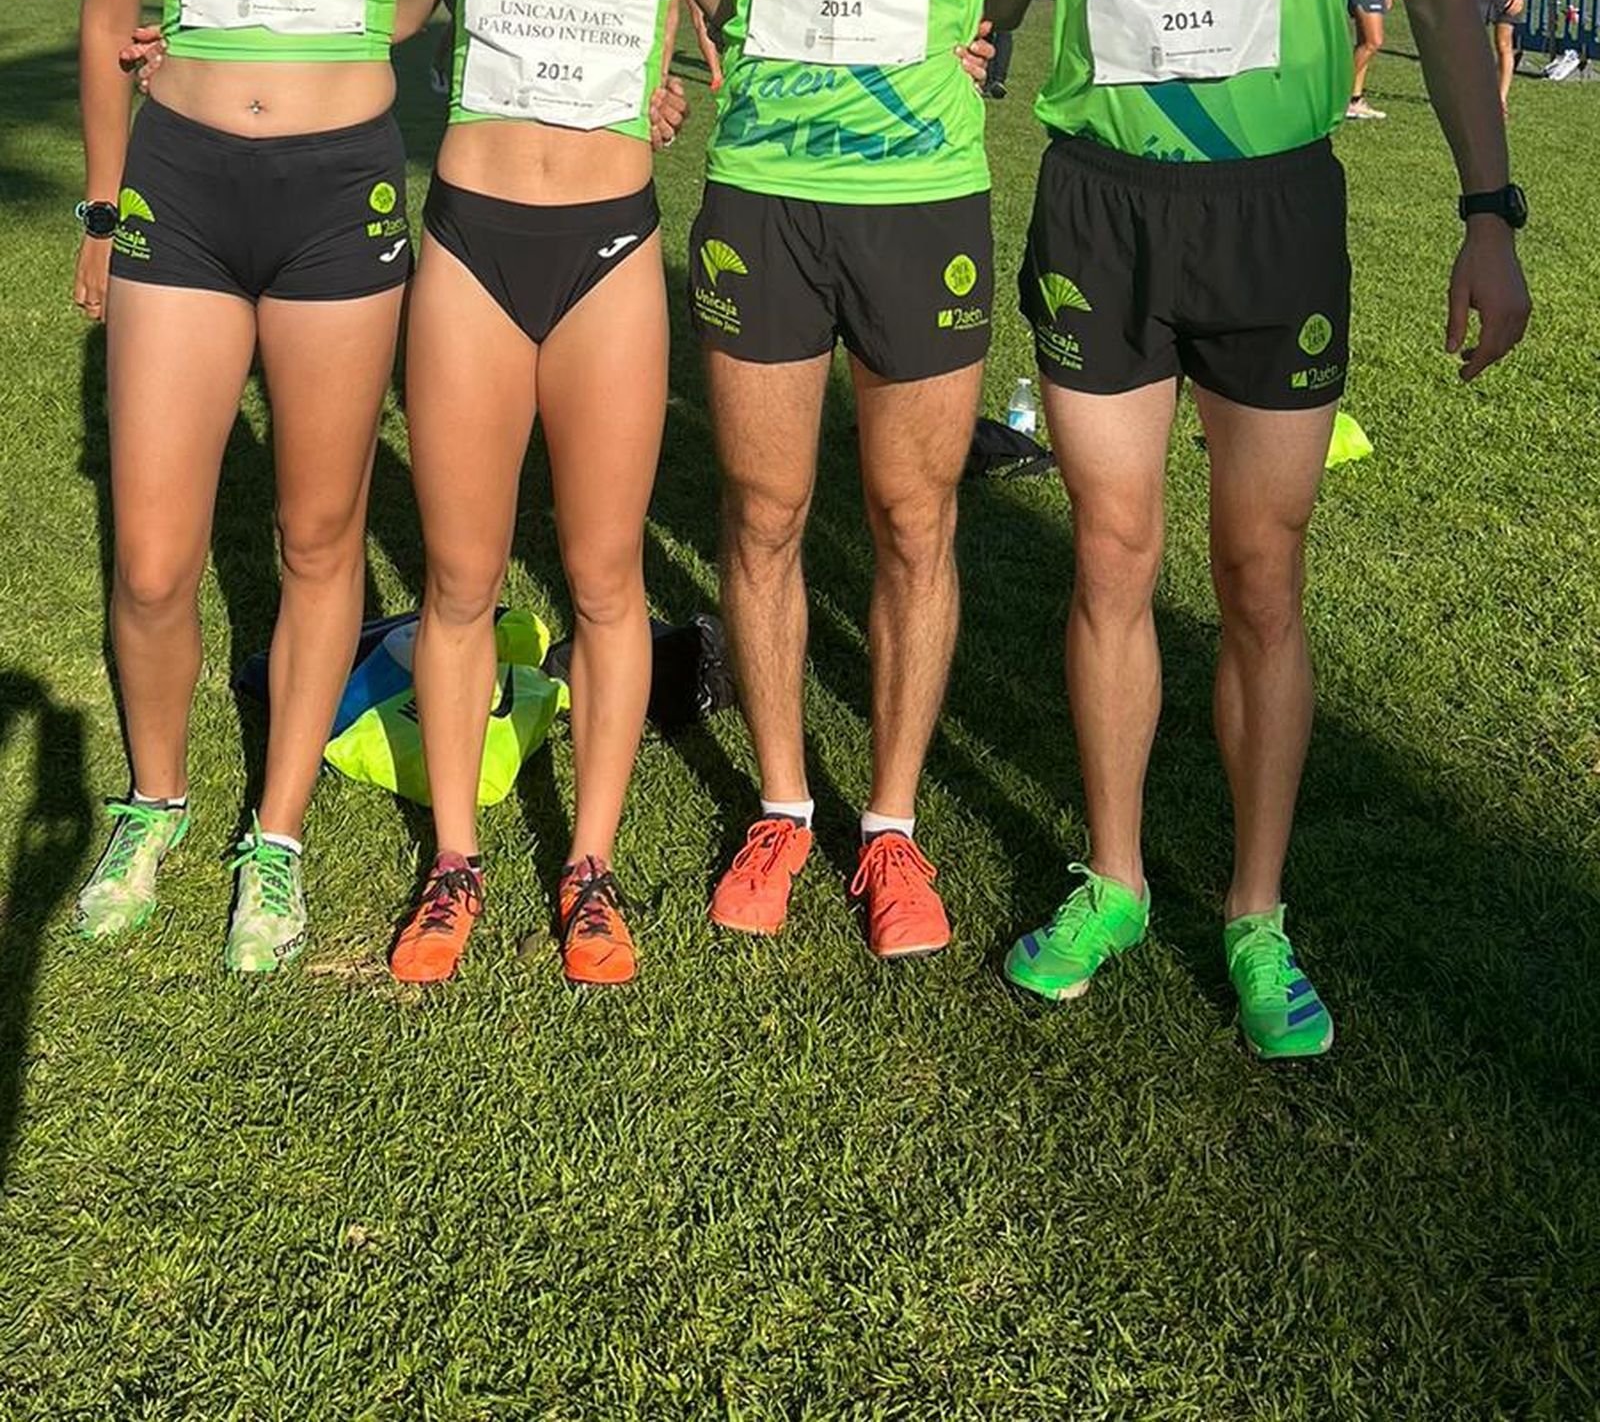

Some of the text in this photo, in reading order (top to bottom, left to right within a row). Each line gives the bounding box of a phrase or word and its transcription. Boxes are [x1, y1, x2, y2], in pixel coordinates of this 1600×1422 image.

[500, 0, 625, 27] UNICAJA JAEN
[820, 0, 863, 18] 2014
[1162, 10, 1214, 31] 2014
[478, 16, 642, 49] PARAISO INTERIOR
[536, 61, 584, 82] 2014
[695, 286, 738, 317] Unicaja
